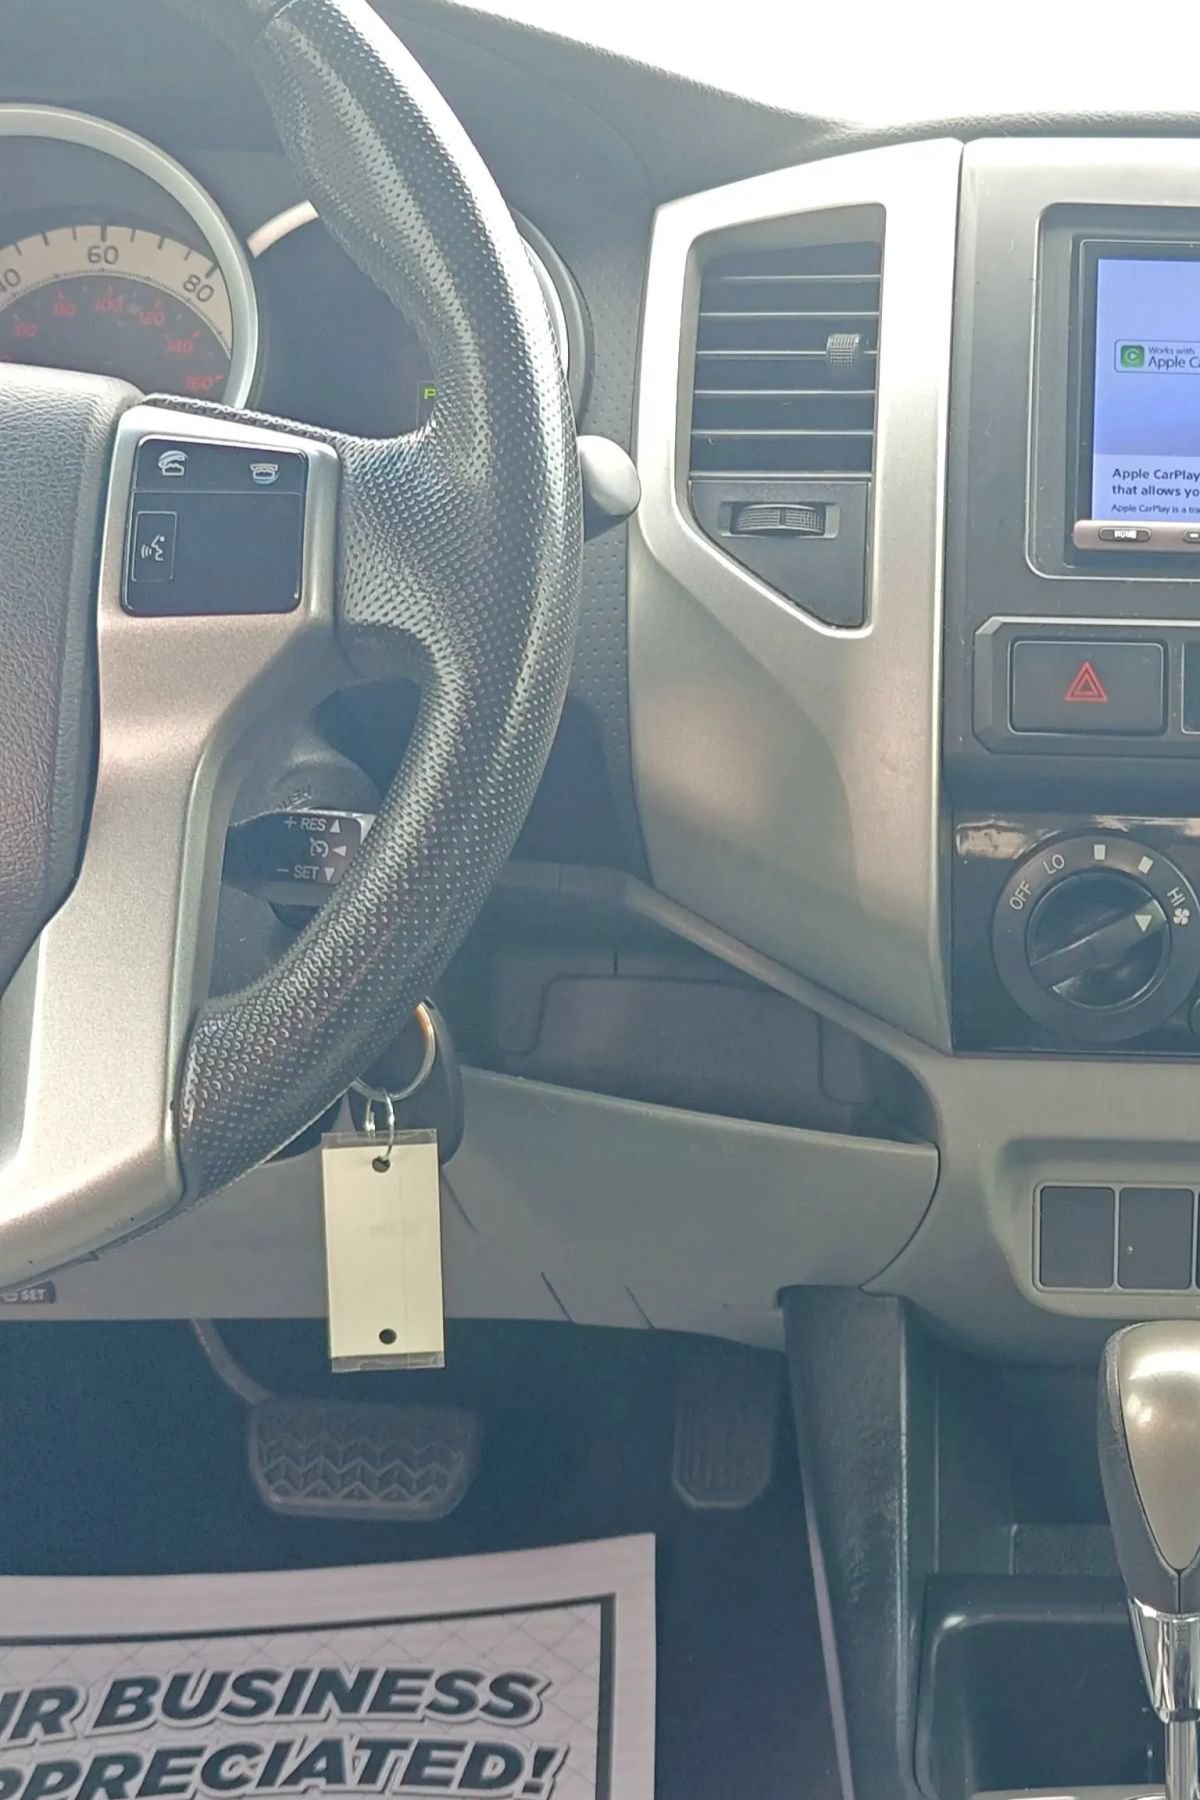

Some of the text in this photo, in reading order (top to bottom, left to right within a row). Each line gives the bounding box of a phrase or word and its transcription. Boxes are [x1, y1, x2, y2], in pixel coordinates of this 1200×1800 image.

[87, 245, 119, 265] 60
[182, 274, 215, 303] 80
[1148, 346, 1195, 355] Works with
[1148, 356, 1186, 371] Apple
[424, 388, 436, 400] P
[1112, 468, 1150, 481] Apple
[1153, 468, 1200, 483] CarPlay
[1112, 484, 1137, 496] that
[1141, 485, 1181, 497] allows
[1111, 504, 1137, 514] Apple
[1139, 504, 1171, 515] CarPlay
[1172, 505, 1179, 514] is
[300, 818, 328, 832] RES
[1042, 853, 1066, 875] LO
[293, 865, 320, 880] SET
[1009, 879, 1033, 911] OFF
[1166, 886, 1187, 907] HI
[92, 1665, 540, 1730] BUSINESS
